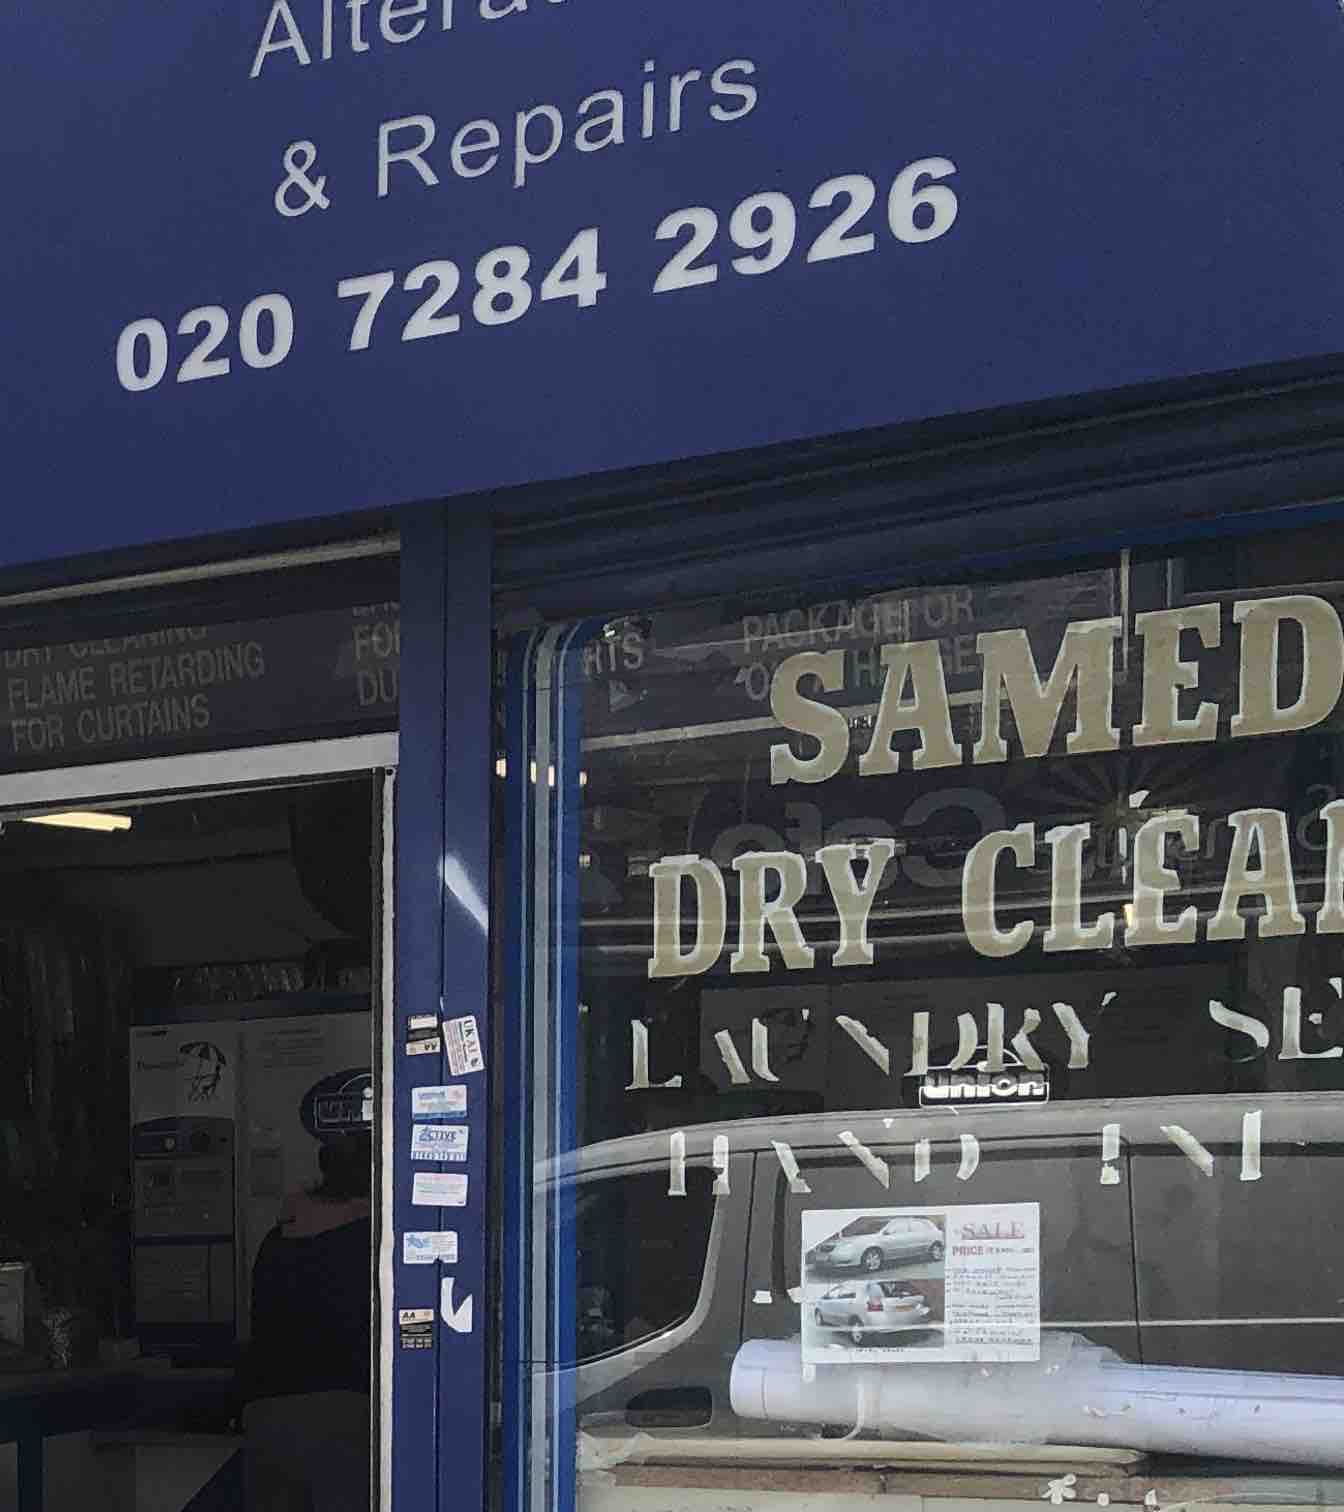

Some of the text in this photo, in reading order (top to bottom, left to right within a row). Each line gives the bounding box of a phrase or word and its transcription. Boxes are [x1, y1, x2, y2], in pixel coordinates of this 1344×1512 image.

[249, 0, 562, 78] Alte
[274, 56, 759, 217] & Repairs
[115, 156, 960, 392] 020 7284 2926
[7, 640, 266, 713] FLAME RETARDING
[11, 693, 211, 754] FOR CURTAINS
[769, 594, 1344, 786] SAMED
[647, 836, 896, 979] DRY
[961, 1221, 1025, 1239] SALE
